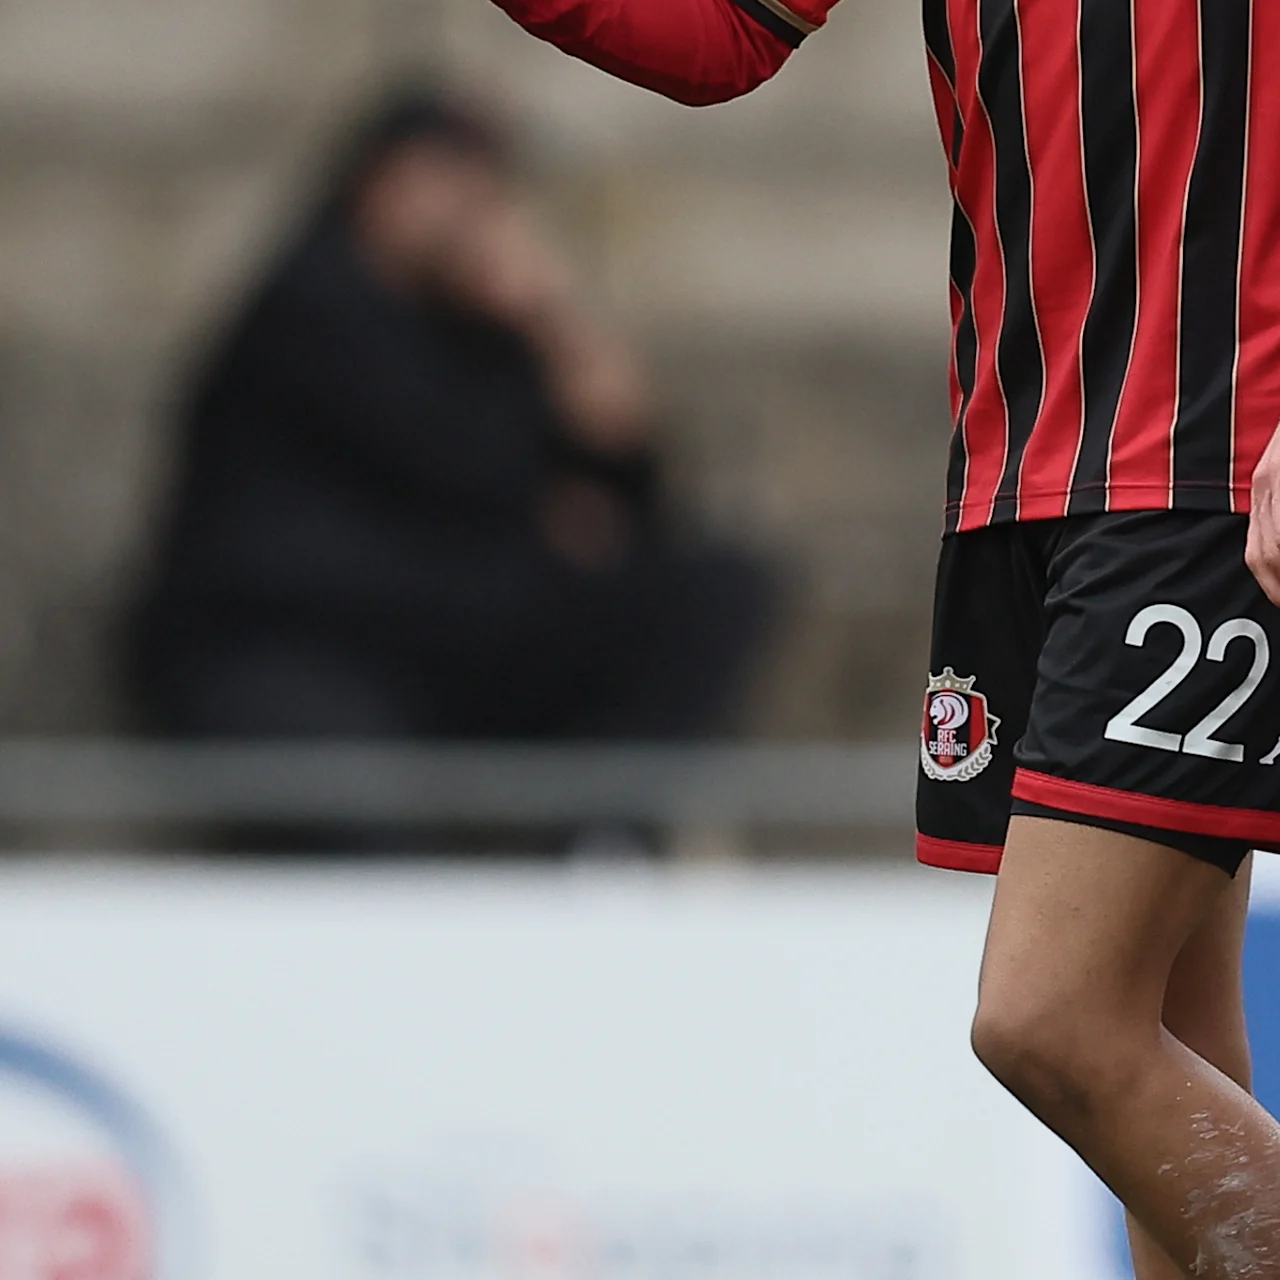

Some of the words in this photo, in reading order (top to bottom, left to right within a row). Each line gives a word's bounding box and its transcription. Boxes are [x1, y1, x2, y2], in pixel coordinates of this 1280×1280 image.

[1103, 603, 1270, 763] 22
[937, 729, 957, 743] RFC
[928, 741, 968, 757] SERAING
